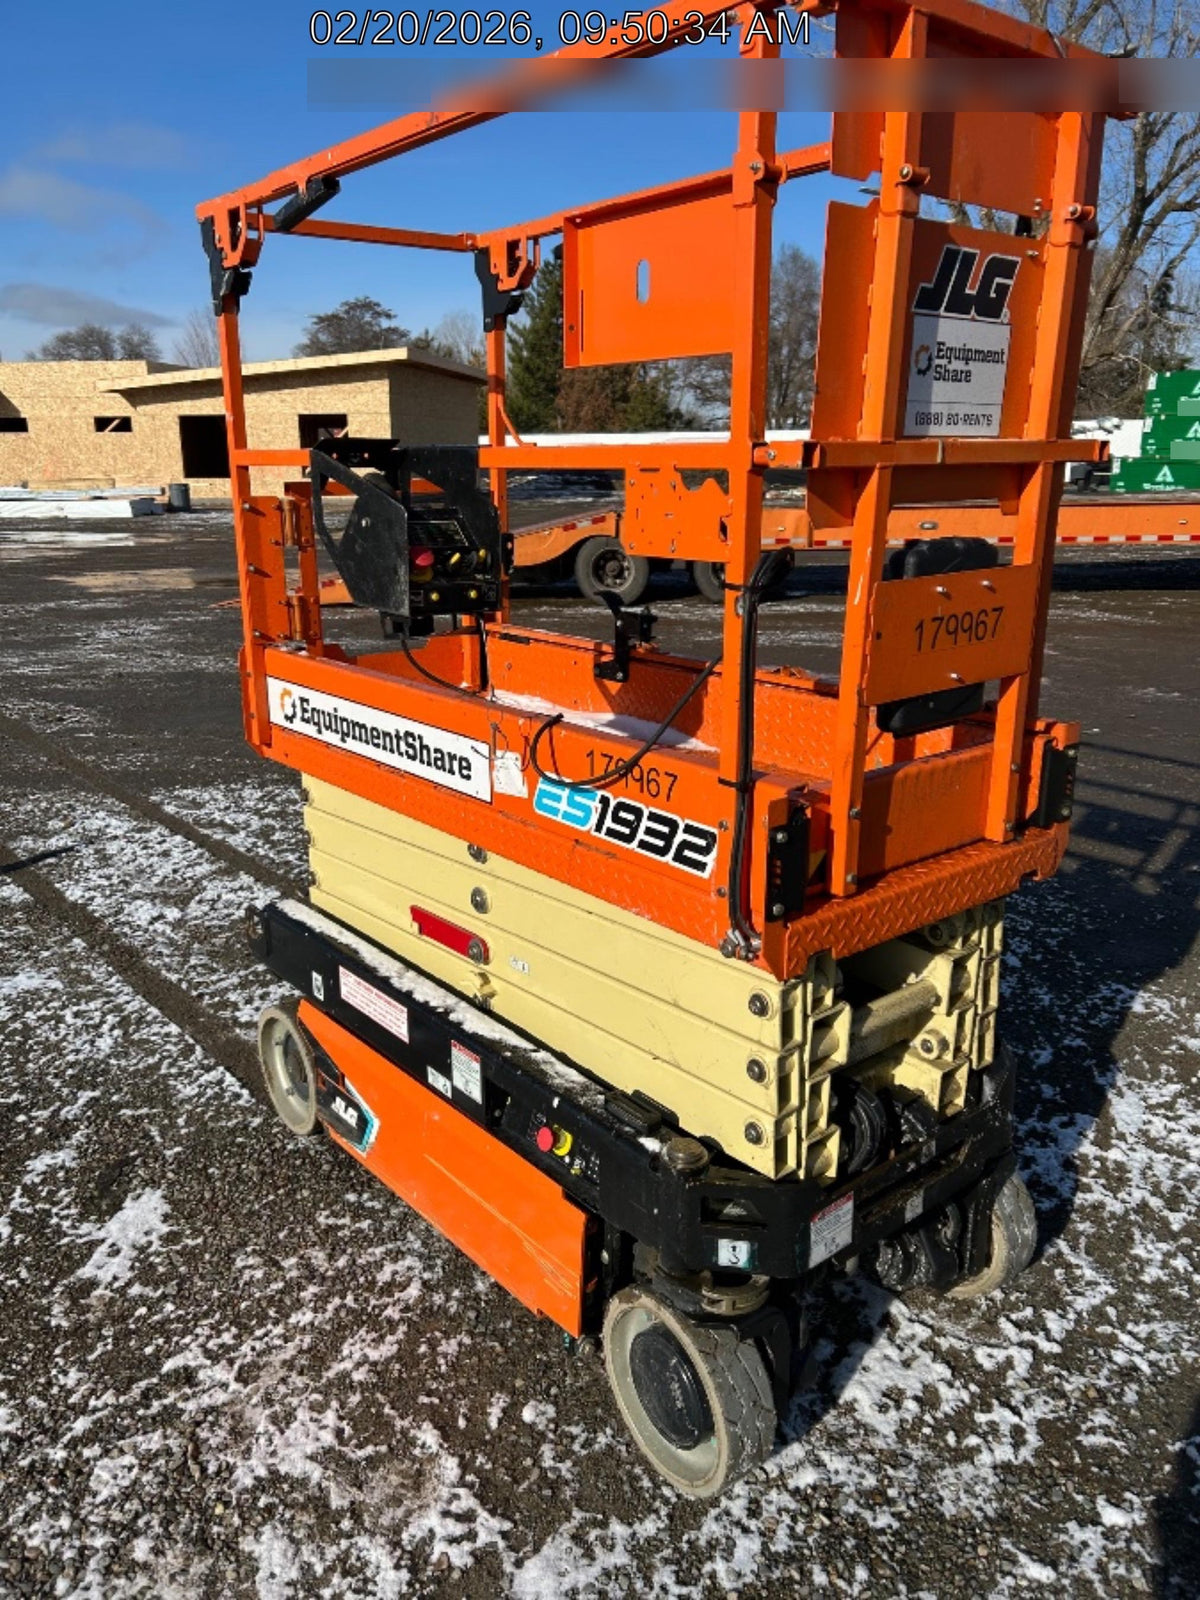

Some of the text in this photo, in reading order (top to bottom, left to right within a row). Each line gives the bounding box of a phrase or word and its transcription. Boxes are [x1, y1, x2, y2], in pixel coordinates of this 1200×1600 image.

[912, 245, 1022, 324] JLG
[933, 364, 972, 383] Share
[935, 342, 1005, 366] Equipment
[914, 606, 1005, 653] 179967
[298, 696, 472, 781] EquipmentShare
[534, 772, 718, 876] ES1932
